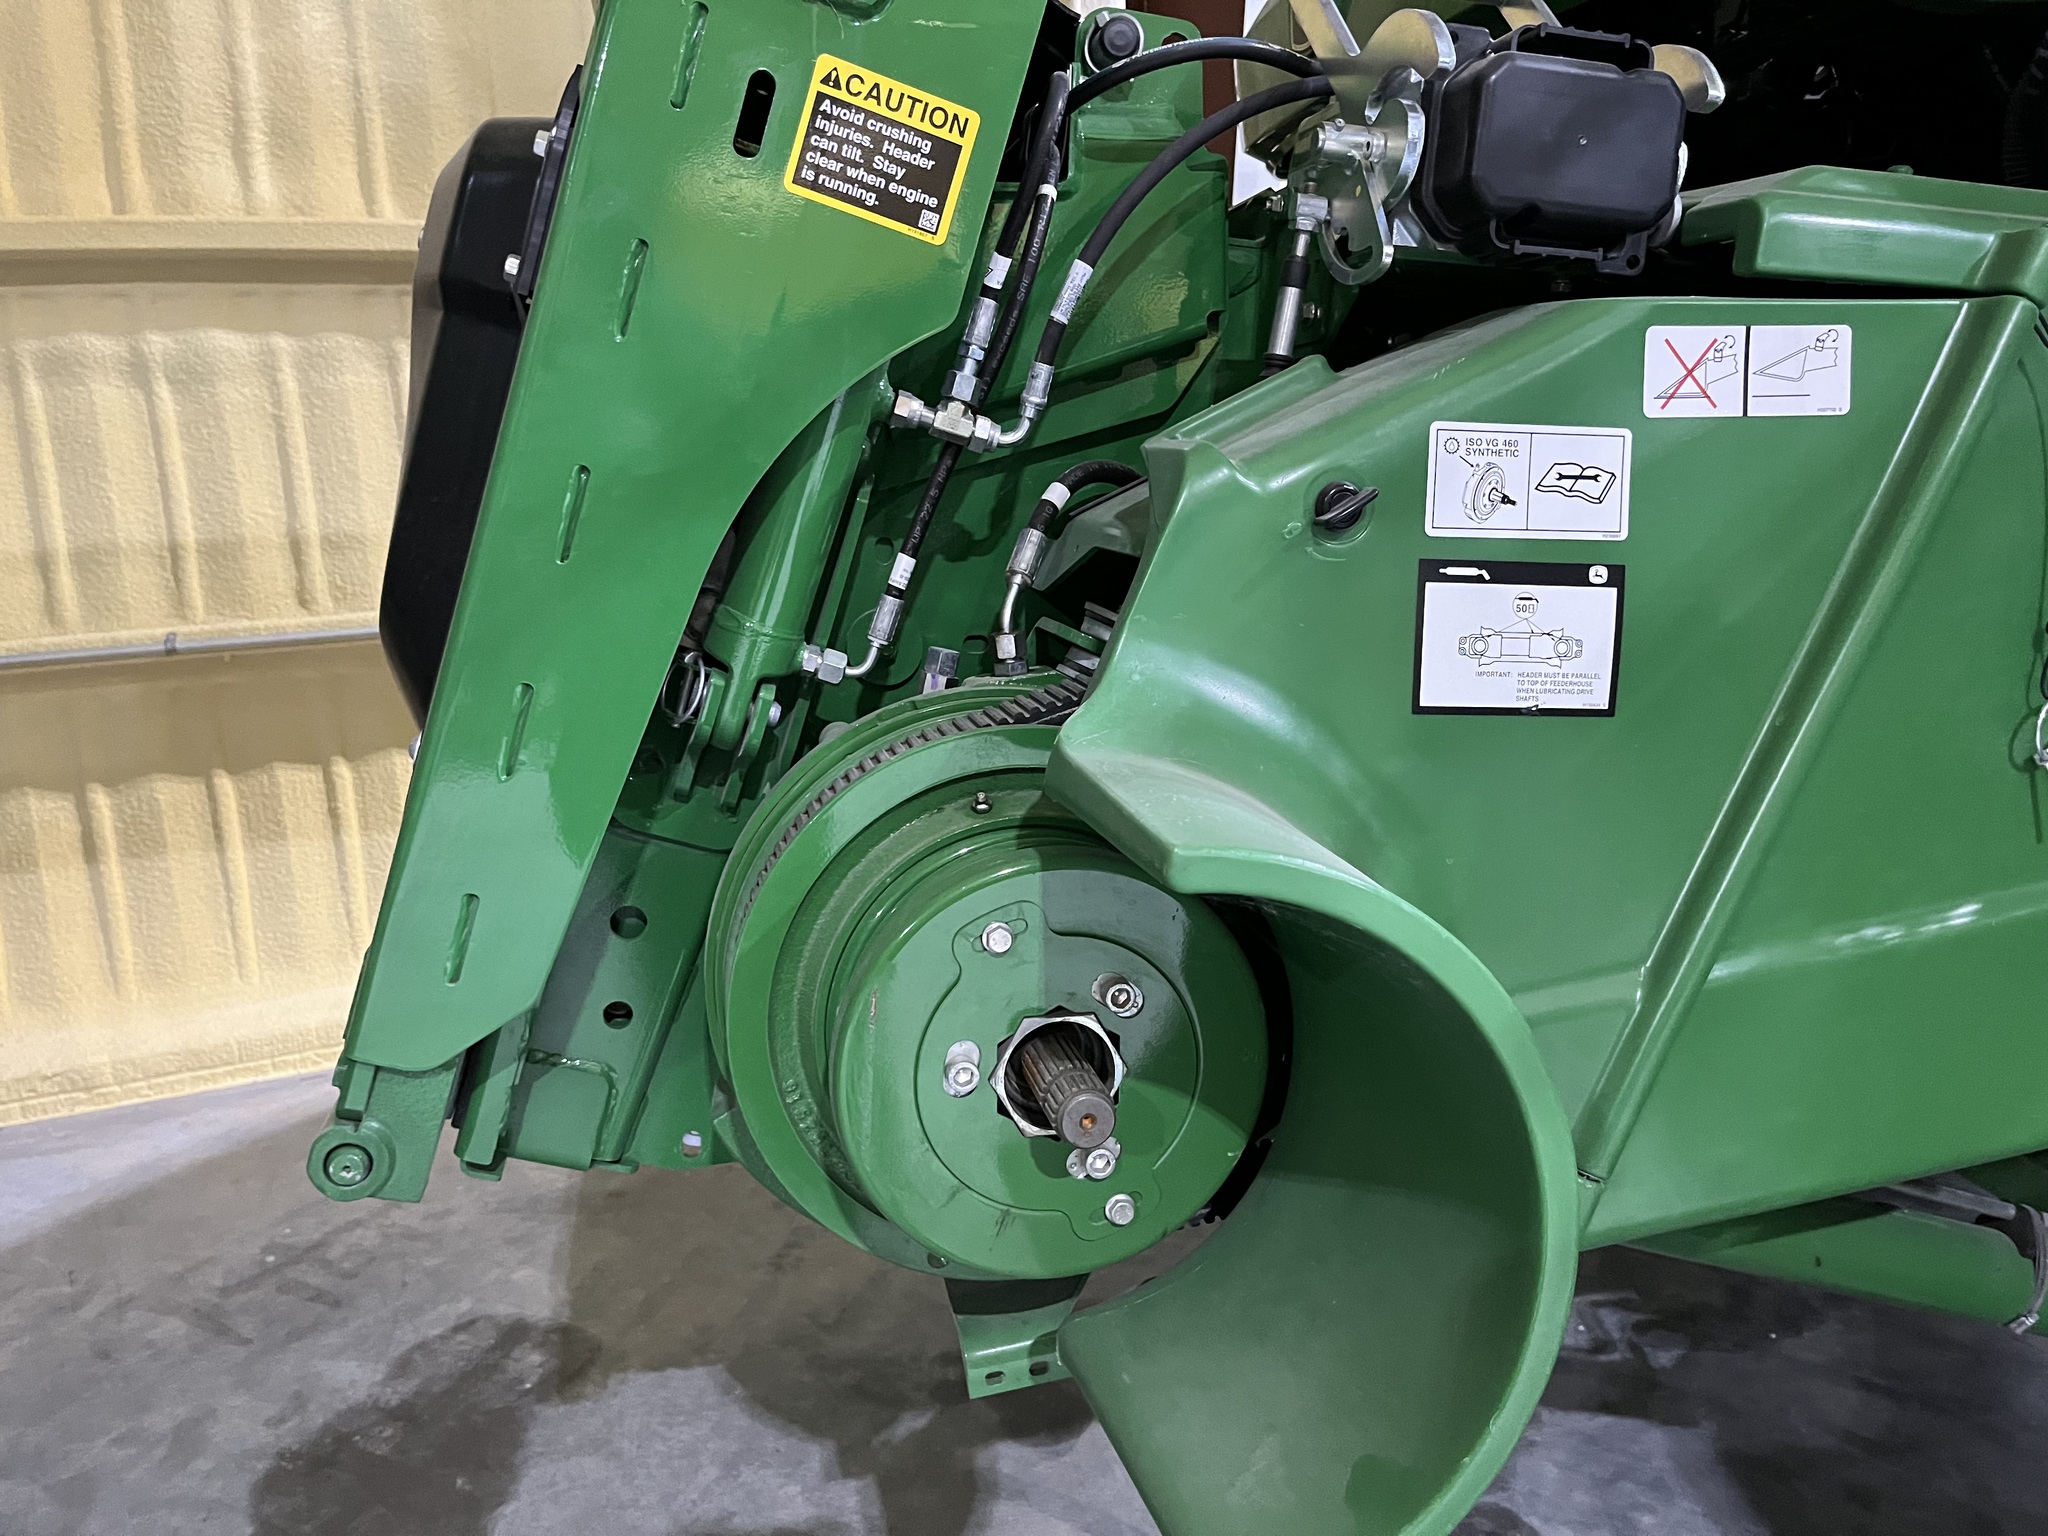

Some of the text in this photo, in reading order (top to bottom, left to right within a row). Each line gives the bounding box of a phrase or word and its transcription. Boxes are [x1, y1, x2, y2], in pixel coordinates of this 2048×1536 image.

[819, 98, 932, 155] Avoid crushing
[845, 73, 969, 138] CAUTION
[810, 134, 906, 180] can tilt. Stay
[815, 114, 936, 171] injuries. Header
[801, 165, 880, 206] is running.
[806, 151, 938, 208] clear when engine
[1016, 274, 1032, 301] SAE
[1028, 239, 1041, 264] 100
[1047, 169, 1056, 183] EN
[1465, 438, 1519, 448] ISO VG 460
[1465, 448, 1519, 458] SYNTHETIC
[1516, 604, 1527, 613] 50
